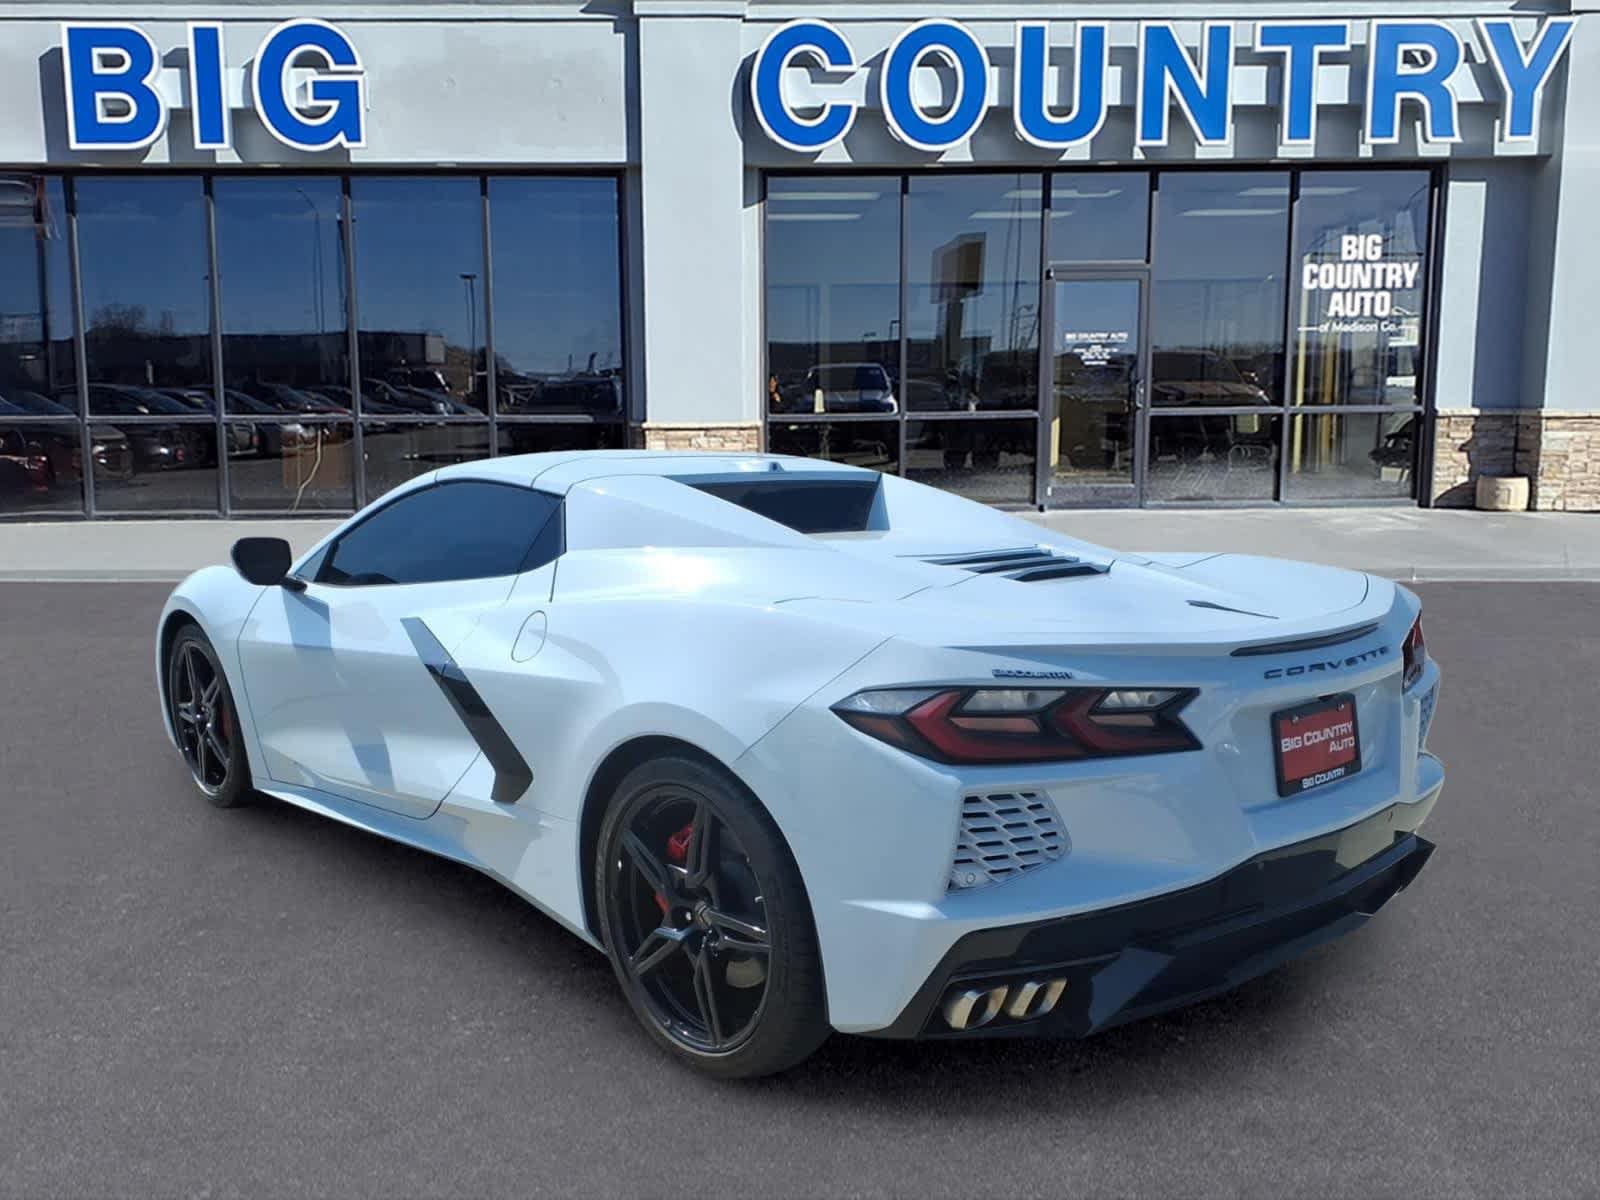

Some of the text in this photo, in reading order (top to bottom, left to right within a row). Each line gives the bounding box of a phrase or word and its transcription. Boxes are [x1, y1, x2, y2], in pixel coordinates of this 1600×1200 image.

[61, 16, 1578, 153] BIG COUNTRY
[1341, 233, 1383, 261] BIG
[1302, 262, 1419, 290] COUNTRY
[1327, 290, 1391, 318] AUTO
[1319, 322, 1330, 333] of
[1331, 321, 1378, 333] Madison
[1263, 645, 1390, 680] CORVETTE
[1281, 721, 1353, 753] BIG COUNTRY
[1329, 735, 1356, 753] AUTO
[1302, 767, 1345, 789] BIG COUNTRY
